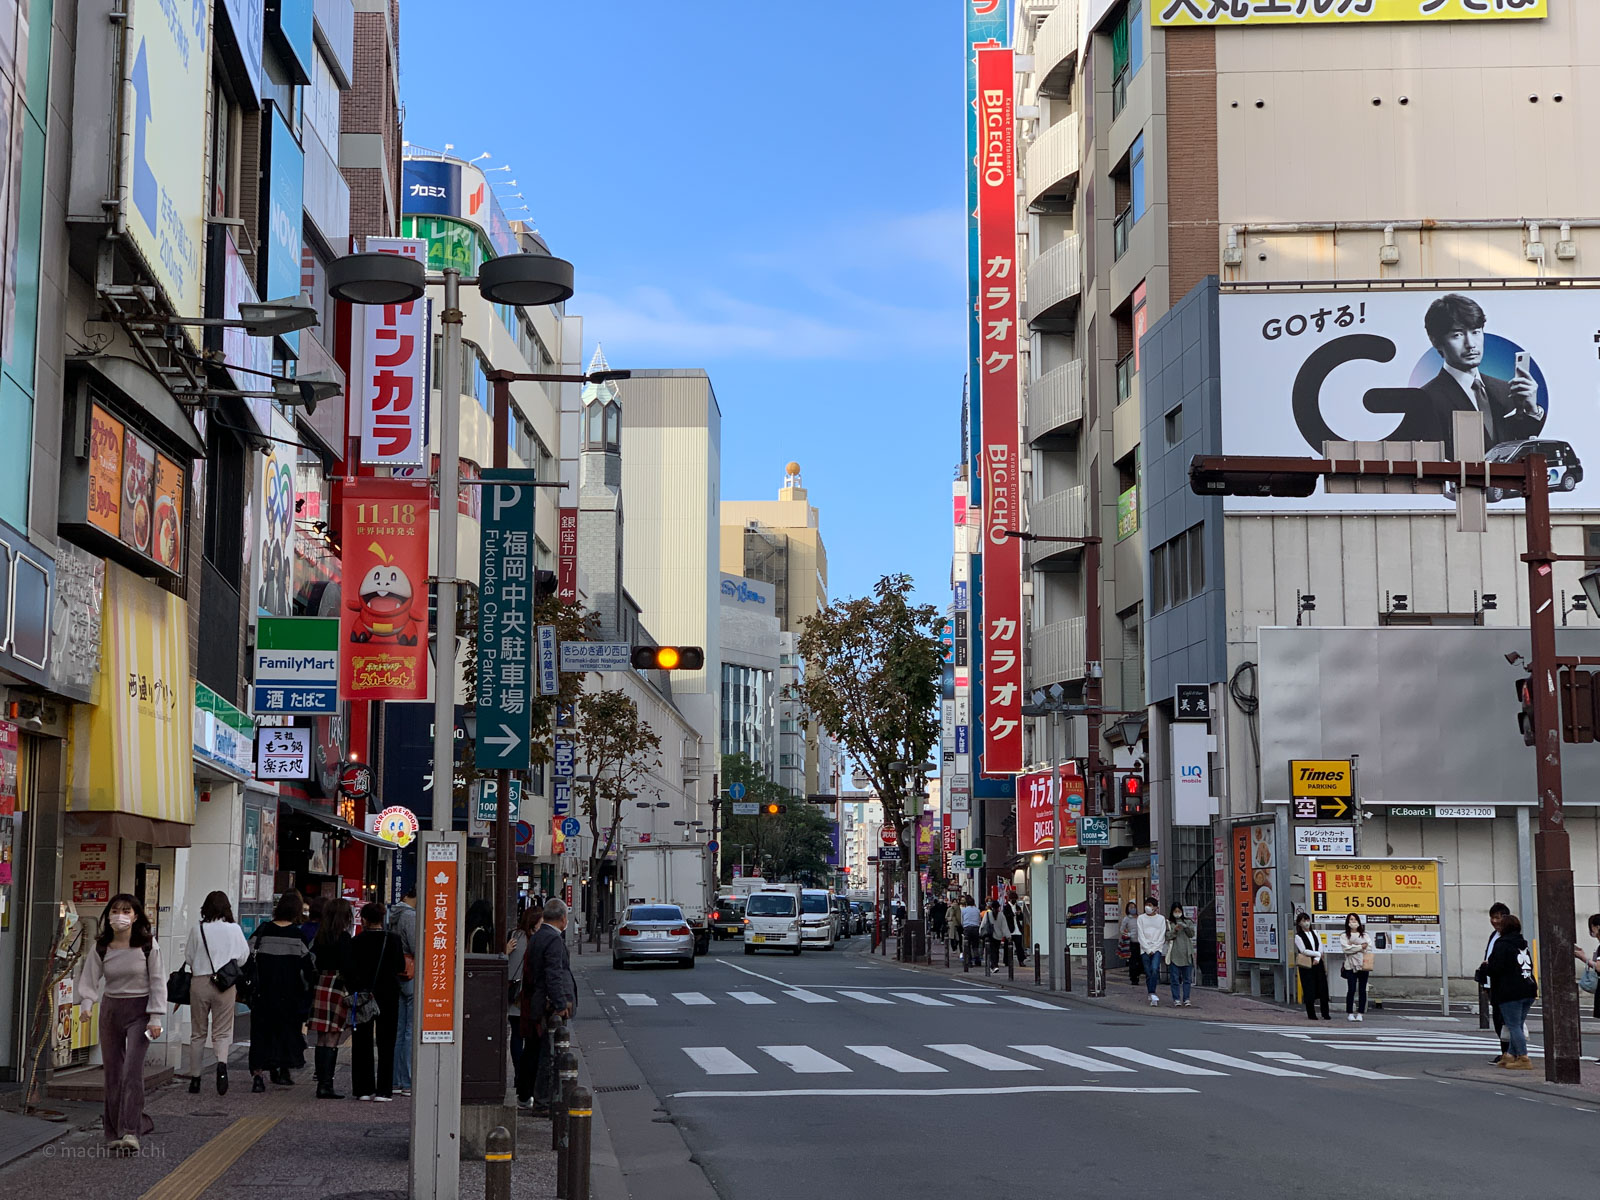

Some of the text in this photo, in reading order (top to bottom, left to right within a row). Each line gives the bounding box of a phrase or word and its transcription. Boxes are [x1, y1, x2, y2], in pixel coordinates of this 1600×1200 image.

[984, 89, 1004, 187] BIG ECHO
[410, 184, 446, 198] プロミス
[272, 199, 299, 267] NOVA
[431, 221, 472, 245] レイク
[986, 255, 1013, 374] カラオケ
[493, 484, 521, 520] P
[988, 444, 1009, 545] BIG ECHO
[357, 504, 416, 524] 11.18
[357, 527, 415, 536] 世界同時発売
[561, 516, 575, 582] 銀座カラー
[560, 588, 574, 598] 4F
[480, 530, 499, 706] Fukuoka Chuo Parking
[500, 530, 528, 714] 福岡中央駐車場
[542, 630, 554, 691] 歩車分離信号
[564, 646, 628, 657] きらめき通り西口
[259, 656, 334, 673] FamilyMart
[360, 672, 409, 685] スカーレット
[990, 617, 1018, 740] カラオケ
[266, 691, 326, 708] 酒 たばこ
[274, 732, 294, 740] 元祖
[265, 741, 303, 753] もつ鍋
[263, 759, 303, 774] 楽天地
[1182, 766, 1202, 778] UQ
[1300, 768, 1344, 781] Times
[341, 770, 370, 792] 一蘭
[484, 781, 497, 798] P
[1295, 798, 1316, 817] 空
[1392, 808, 1432, 816] FC.Board-1
[1084, 818, 1093, 830] P
[1239, 836, 1250, 949] Royal Host
[433, 893, 448, 950] 古賀文敏
